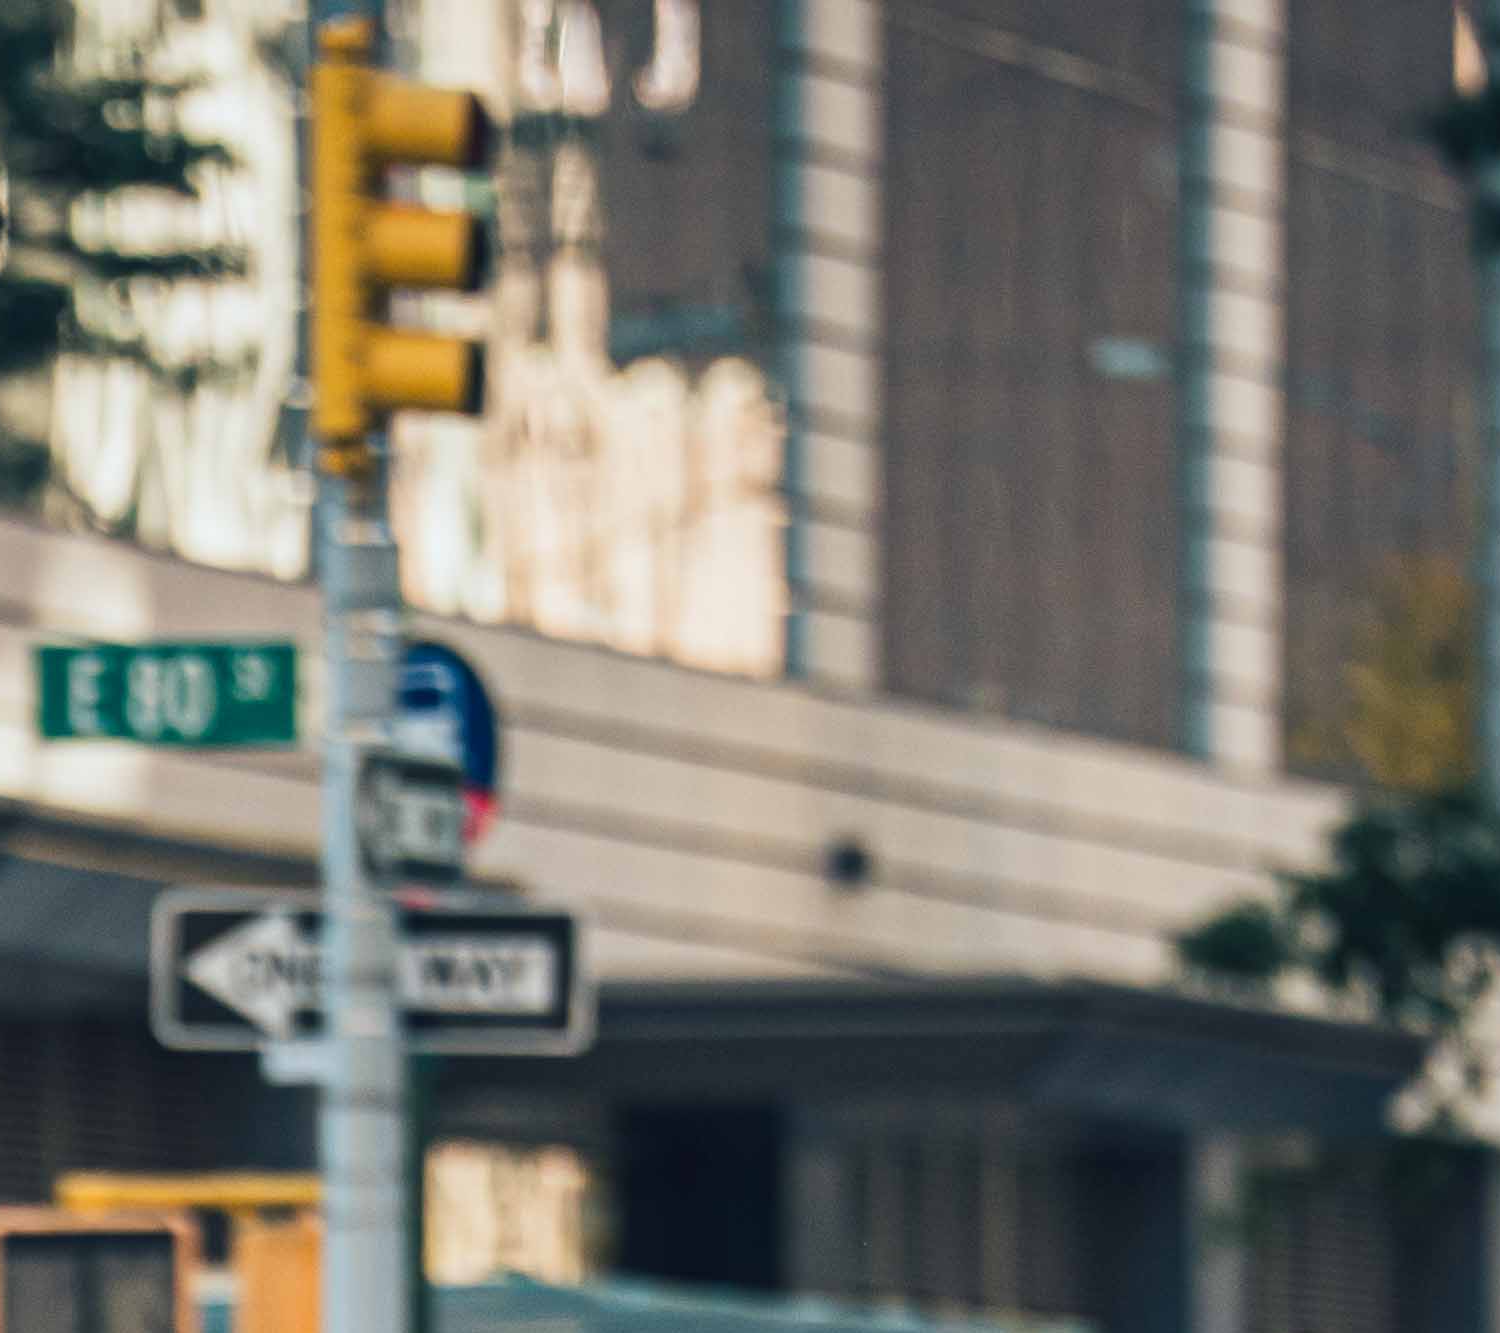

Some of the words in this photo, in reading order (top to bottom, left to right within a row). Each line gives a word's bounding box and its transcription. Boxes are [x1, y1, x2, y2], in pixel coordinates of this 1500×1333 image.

[67, 653, 106, 736] E
[124, 652, 217, 739] 80
[421, 949, 524, 993] WAY
